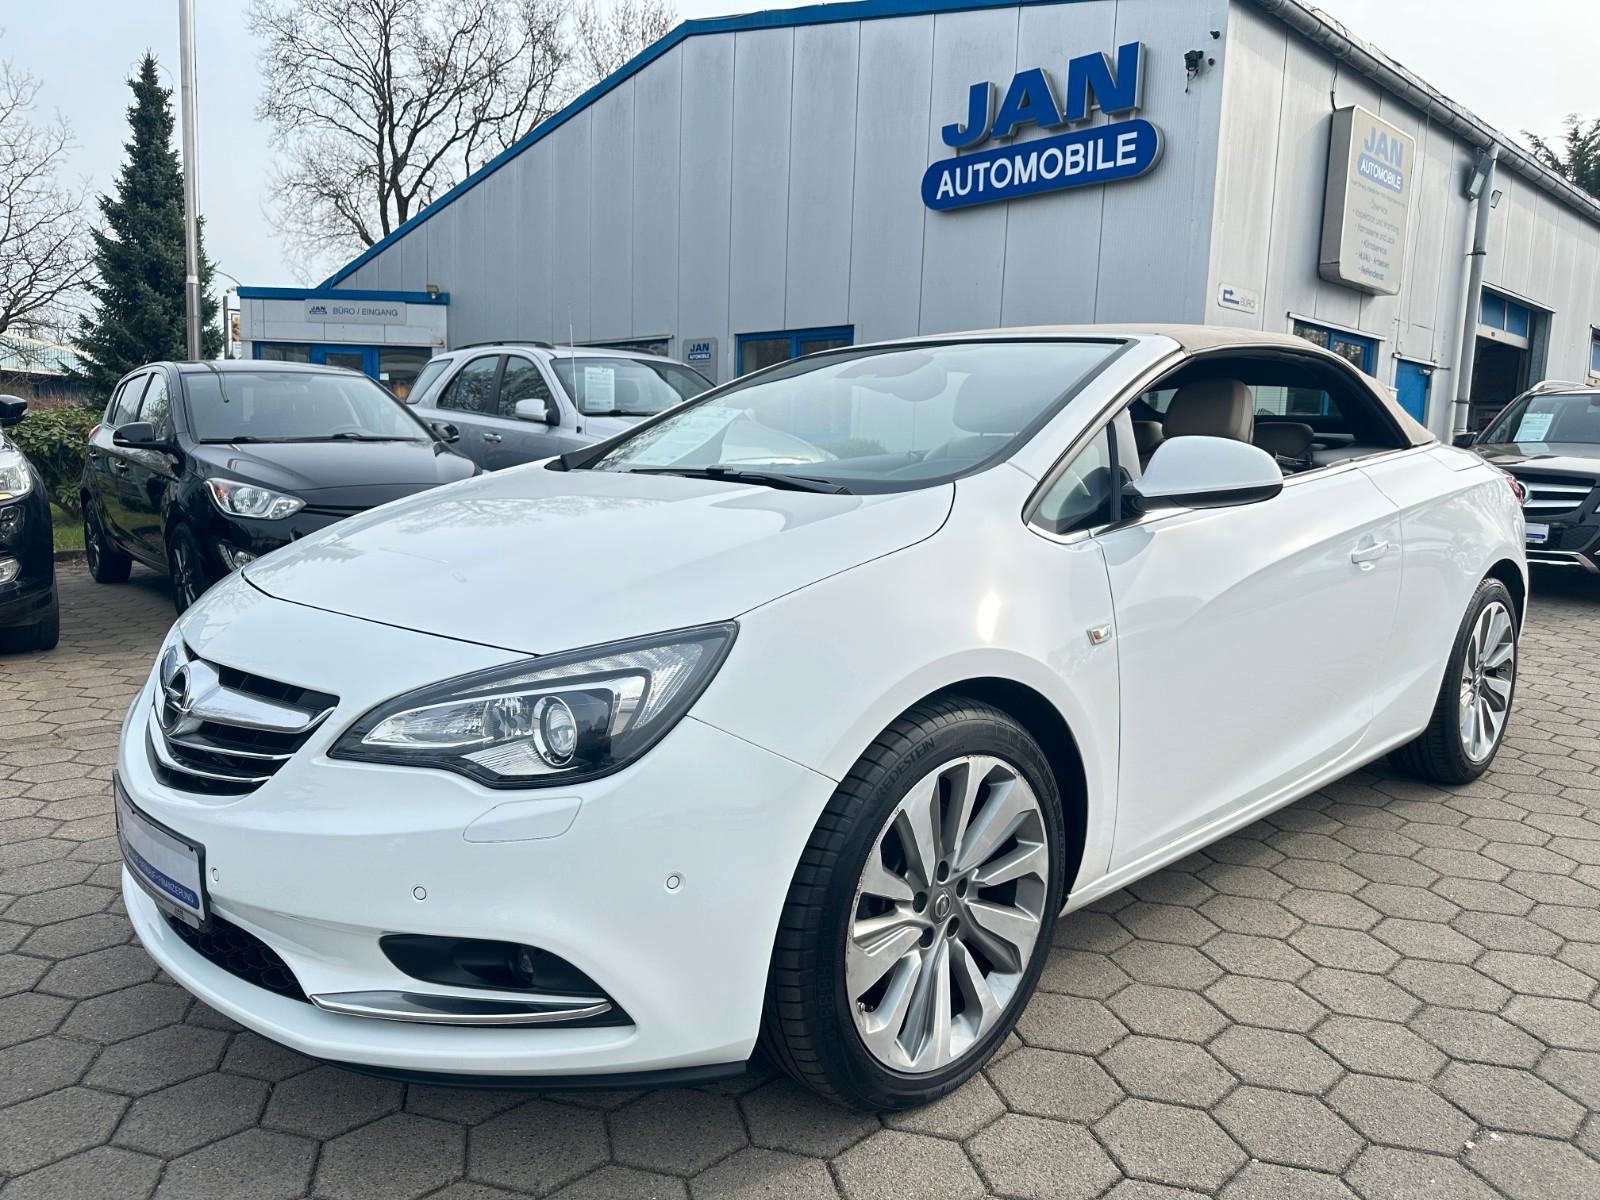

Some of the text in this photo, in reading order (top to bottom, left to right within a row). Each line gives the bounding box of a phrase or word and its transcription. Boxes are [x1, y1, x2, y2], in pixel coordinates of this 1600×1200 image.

[941, 41, 1144, 148] JAN
[1364, 127, 1403, 168] JAN
[936, 131, 1138, 200] AUTOMOBILE
[1360, 159, 1401, 189] AUTOMOBILE
[332, 305, 355, 316] BÜRO
[361, 307, 399, 317] EINGANG
[690, 343, 709, 352] JAN
